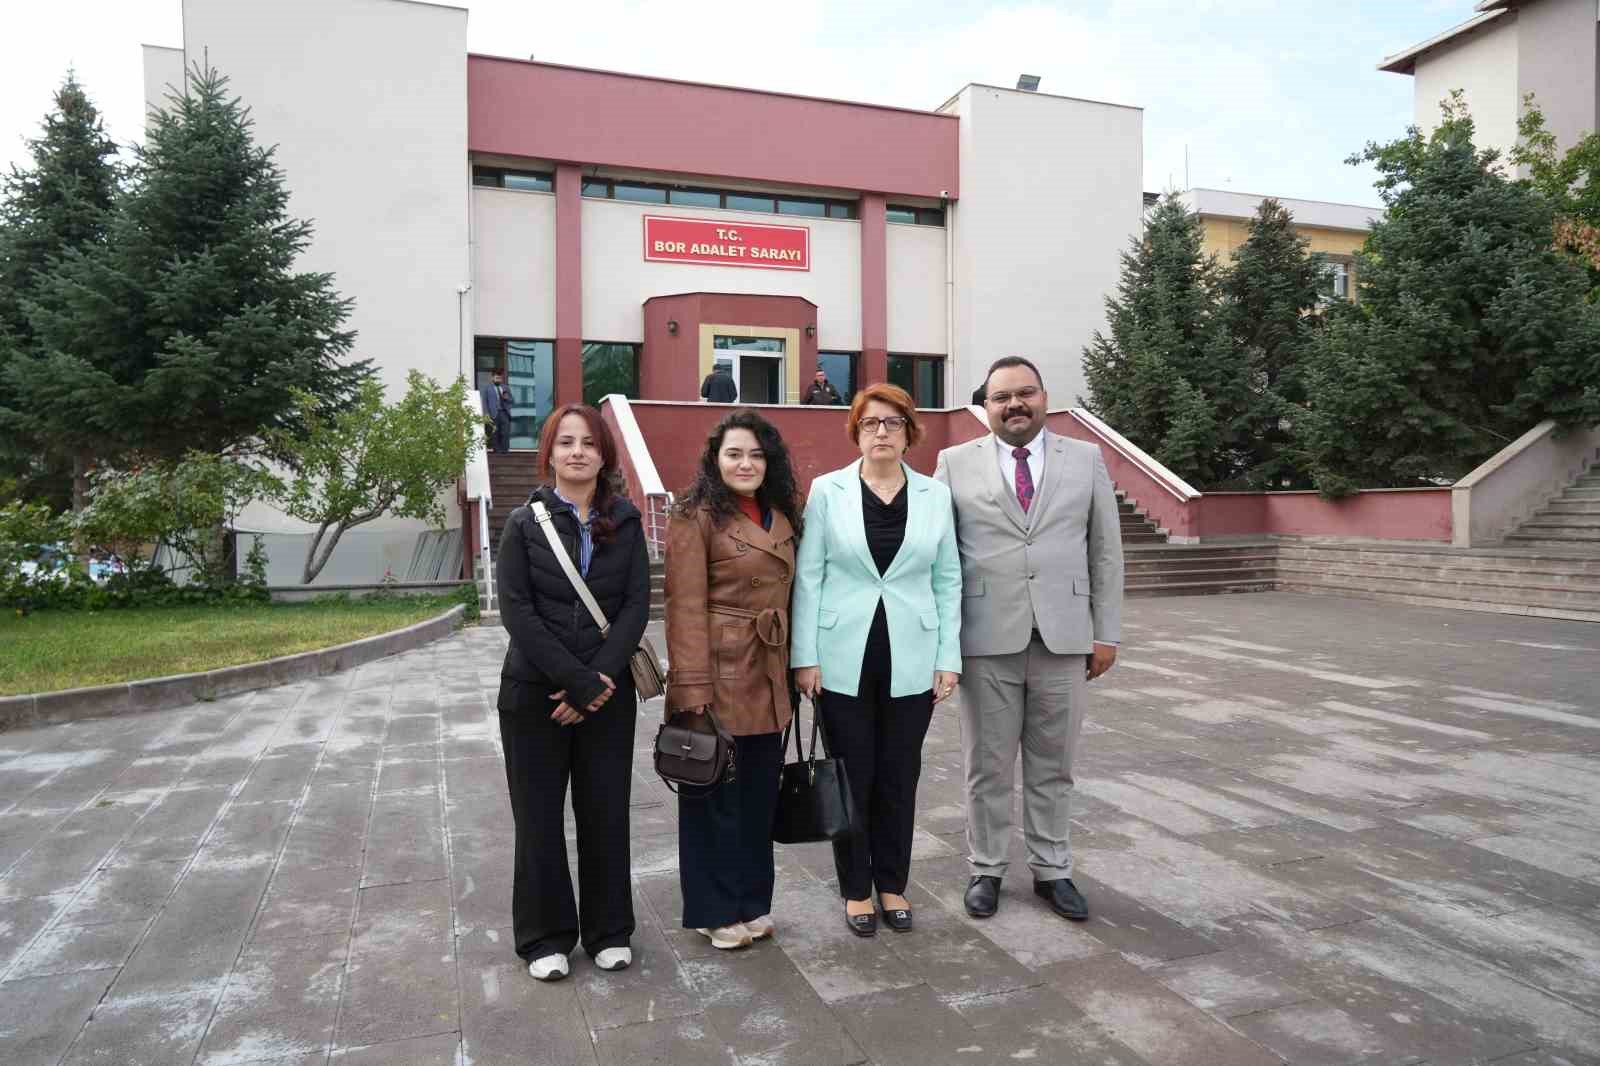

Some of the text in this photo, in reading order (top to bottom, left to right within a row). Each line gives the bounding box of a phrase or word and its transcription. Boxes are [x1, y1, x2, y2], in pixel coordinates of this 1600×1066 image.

[716, 228, 742, 241] T.C.
[654, 240, 801, 261] BOR ADALET SARAYI
